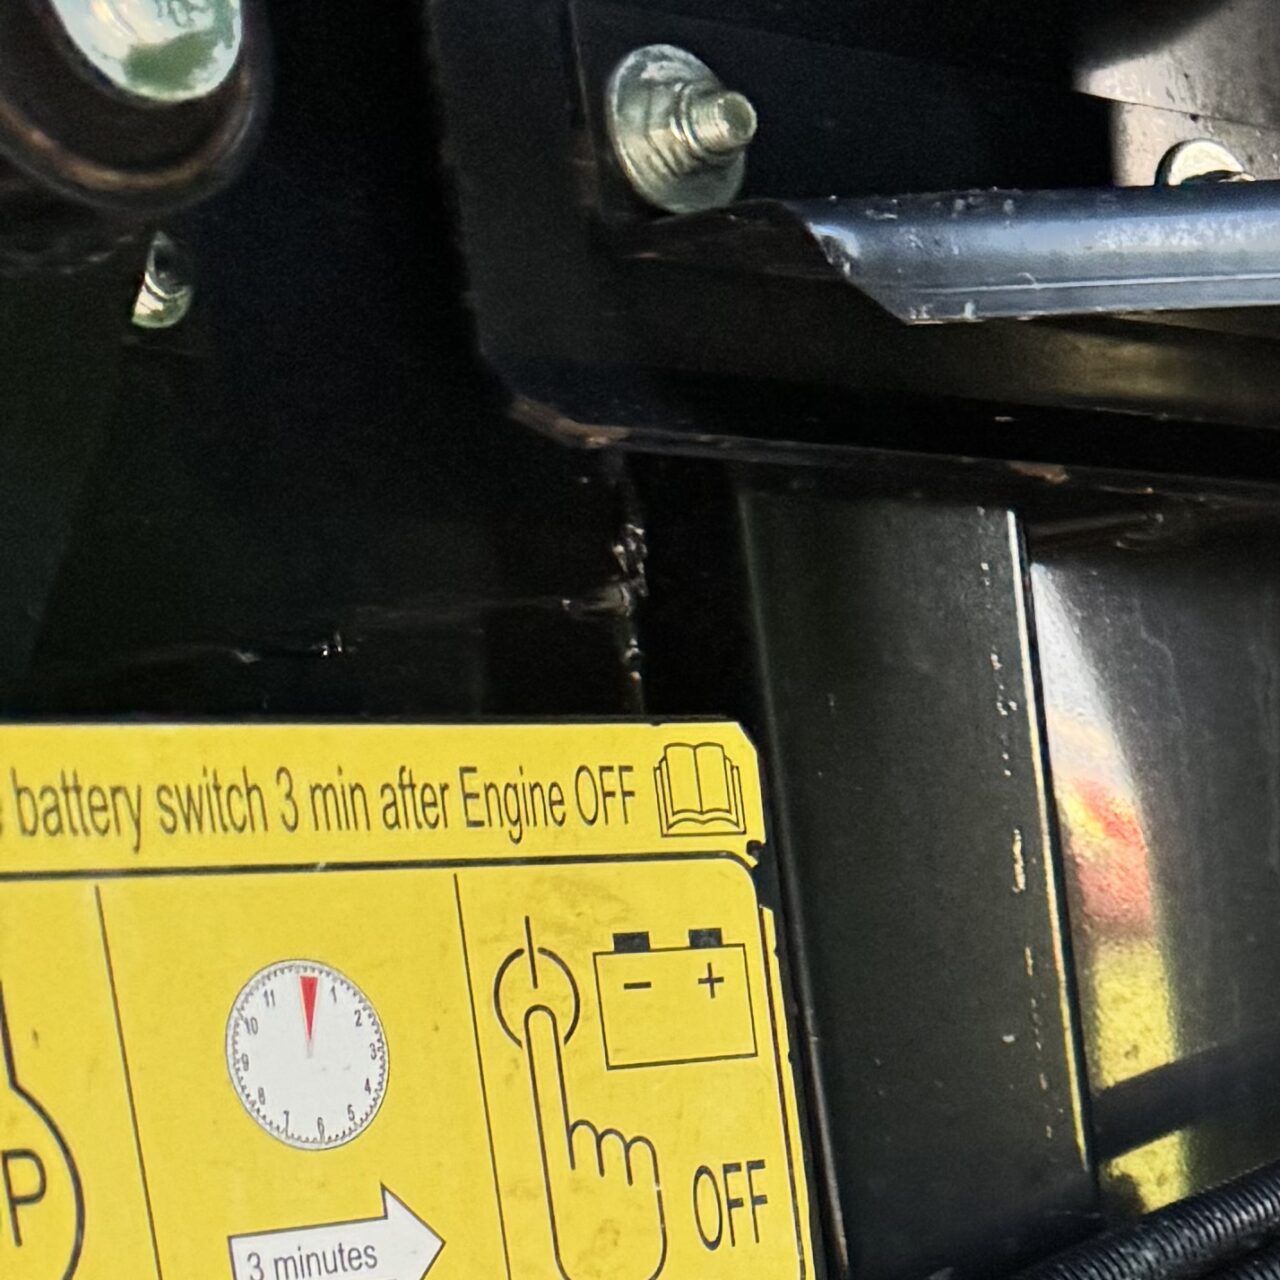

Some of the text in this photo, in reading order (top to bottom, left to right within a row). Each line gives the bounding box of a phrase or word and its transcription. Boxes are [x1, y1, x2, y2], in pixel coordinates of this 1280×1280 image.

[9, 766, 142, 854] battery
[156, 766, 269, 835] switch
[276, 765, 300, 833] 3
[309, 765, 371, 832] min
[380, 765, 450, 831] after
[459, 765, 567, 845] Engine
[574, 764, 636, 827] OFF
[263, 988, 275, 1008] 11
[330, 985, 337, 1003] 1
[354, 1009, 363, 1027] 2
[369, 1043, 378, 1060] 3
[364, 1077, 372, 1095] 4
[347, 1104, 355, 1122] 5
[317, 1117, 325, 1137] 6
[692, 1159, 768, 1251] OFF
